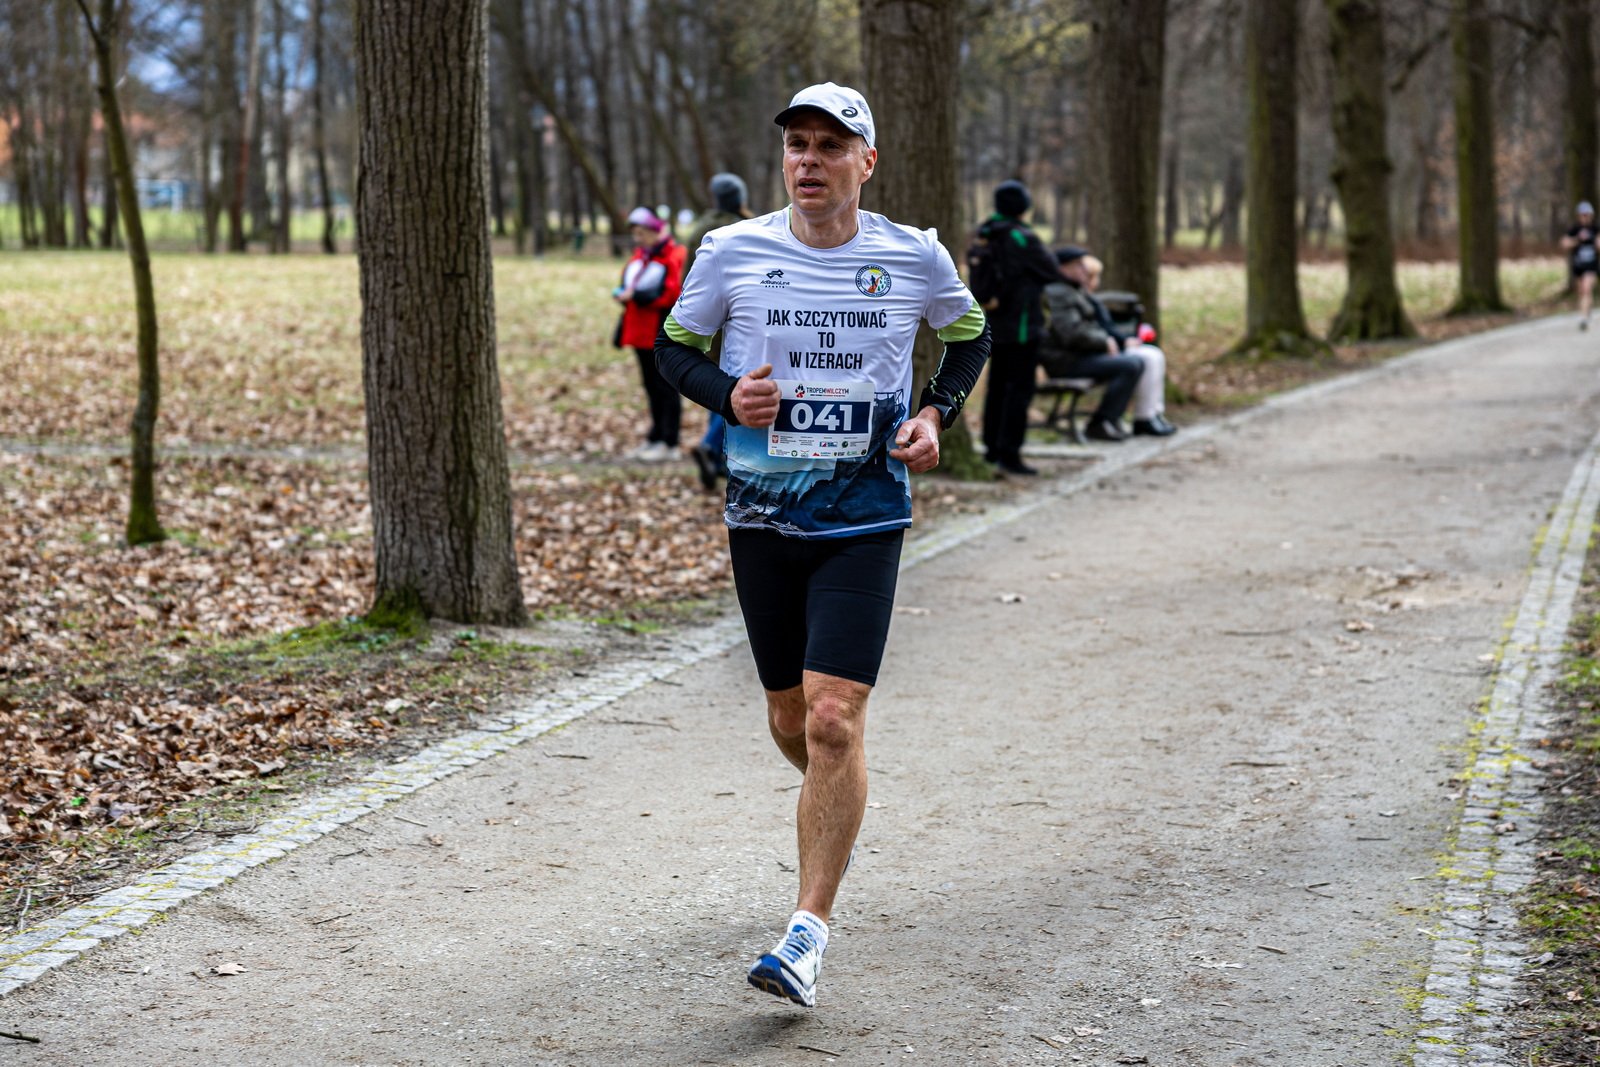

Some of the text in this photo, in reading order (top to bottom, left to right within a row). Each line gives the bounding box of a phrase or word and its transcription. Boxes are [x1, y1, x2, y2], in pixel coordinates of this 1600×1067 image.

[766, 309, 887, 328] JAK SZCZYTOWAĆ
[817, 332, 835, 348] TO
[789, 351, 863, 370] W IZERACH
[790, 402, 853, 431] 041
